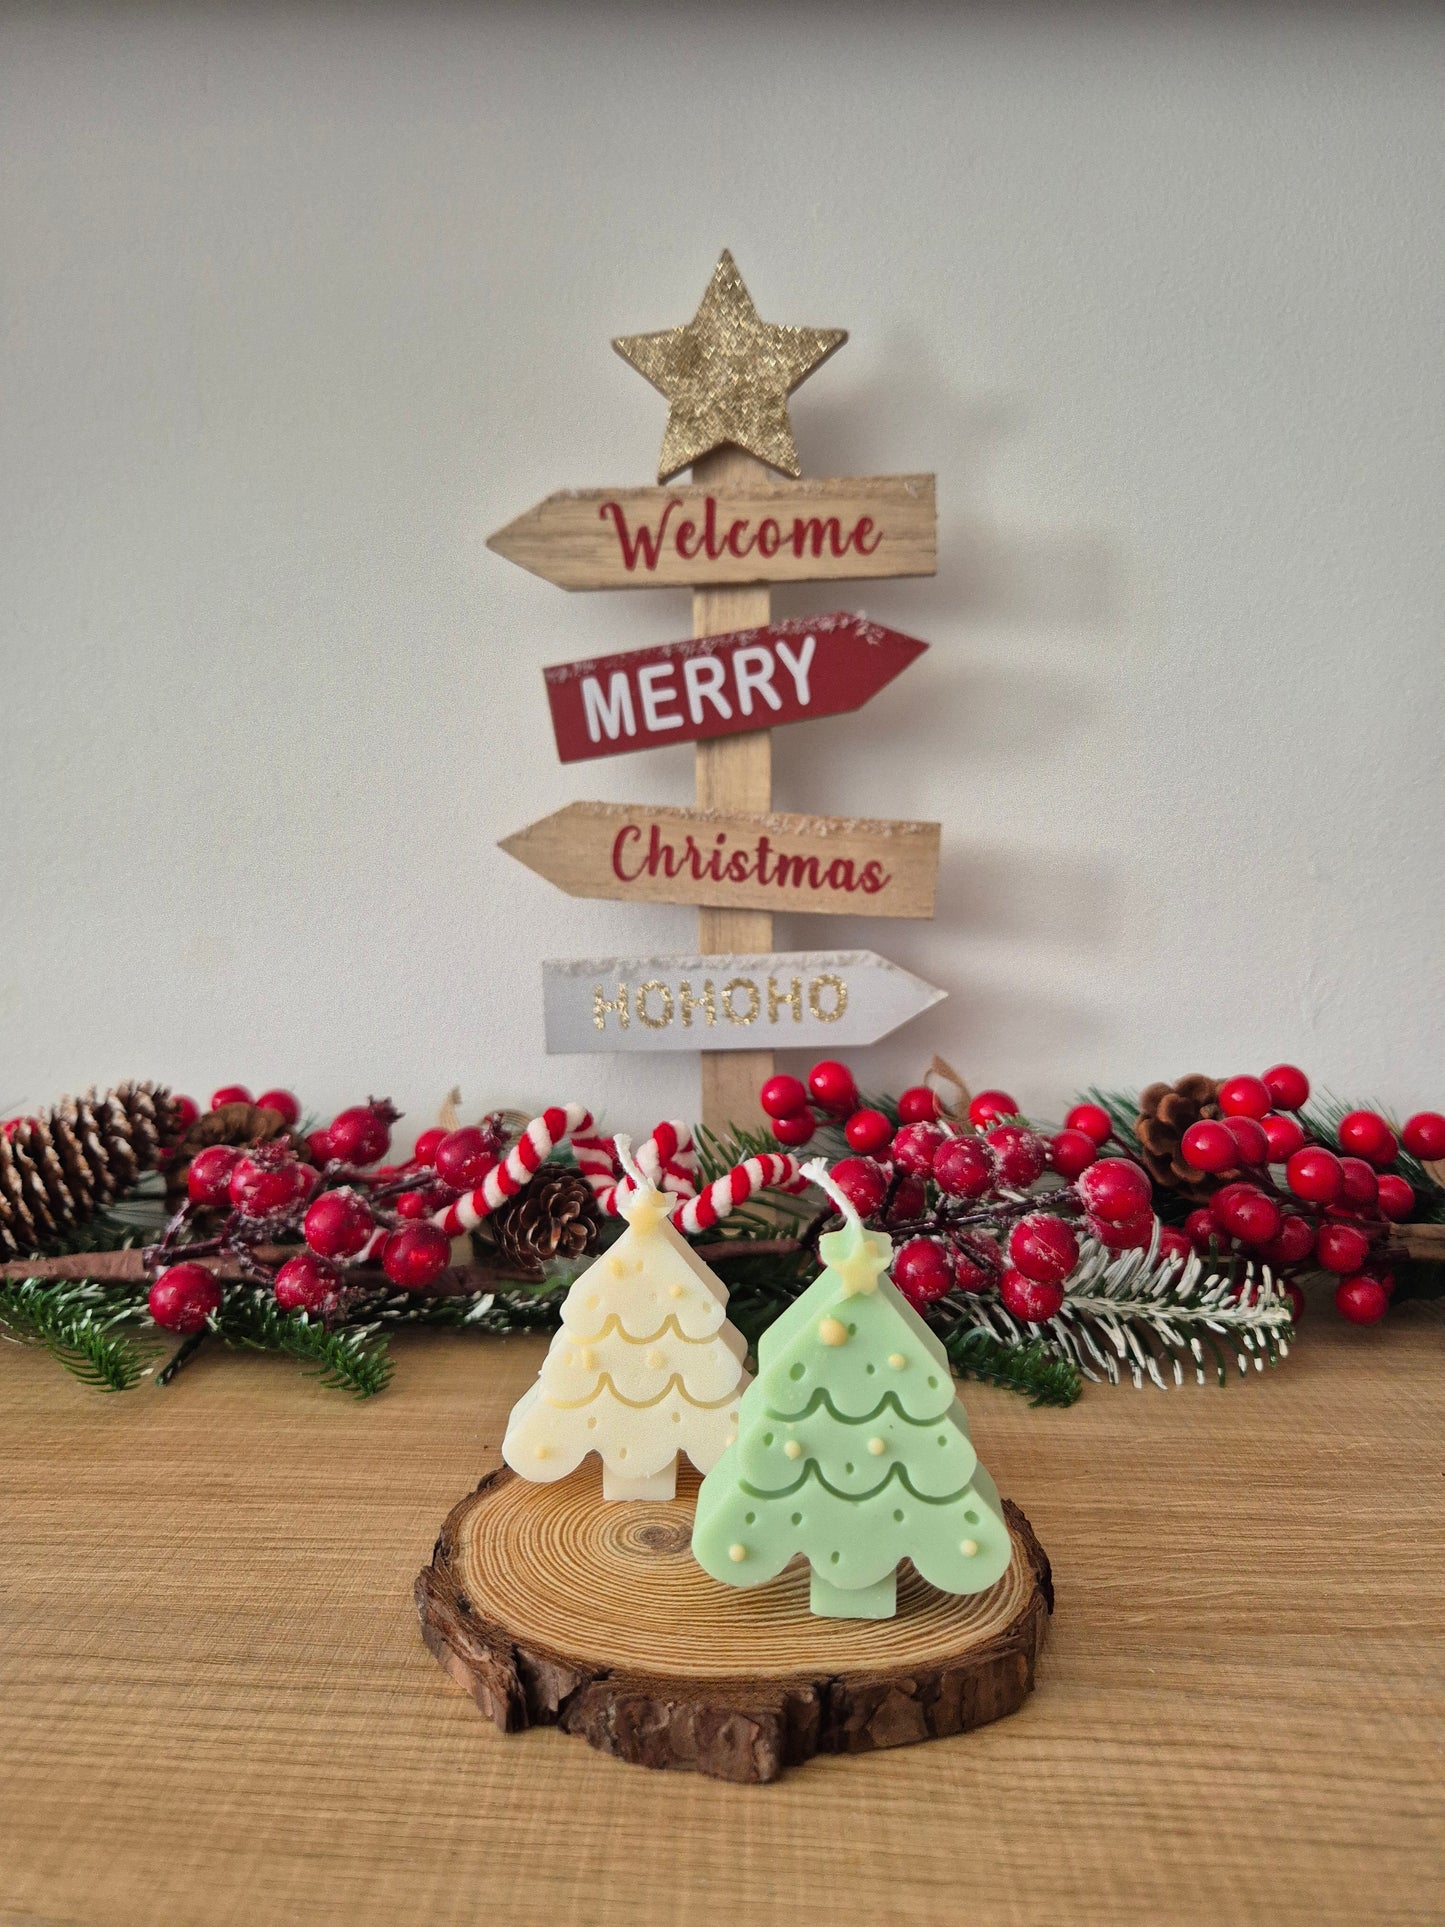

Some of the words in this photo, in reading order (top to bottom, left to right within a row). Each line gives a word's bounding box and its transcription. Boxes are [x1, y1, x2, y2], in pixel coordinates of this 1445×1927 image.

[600, 497, 883, 570] Welcome
[581, 635, 817, 743] MERRY
[612, 824, 891, 894] Christmas
[593, 974, 848, 1030] HOHOHO
